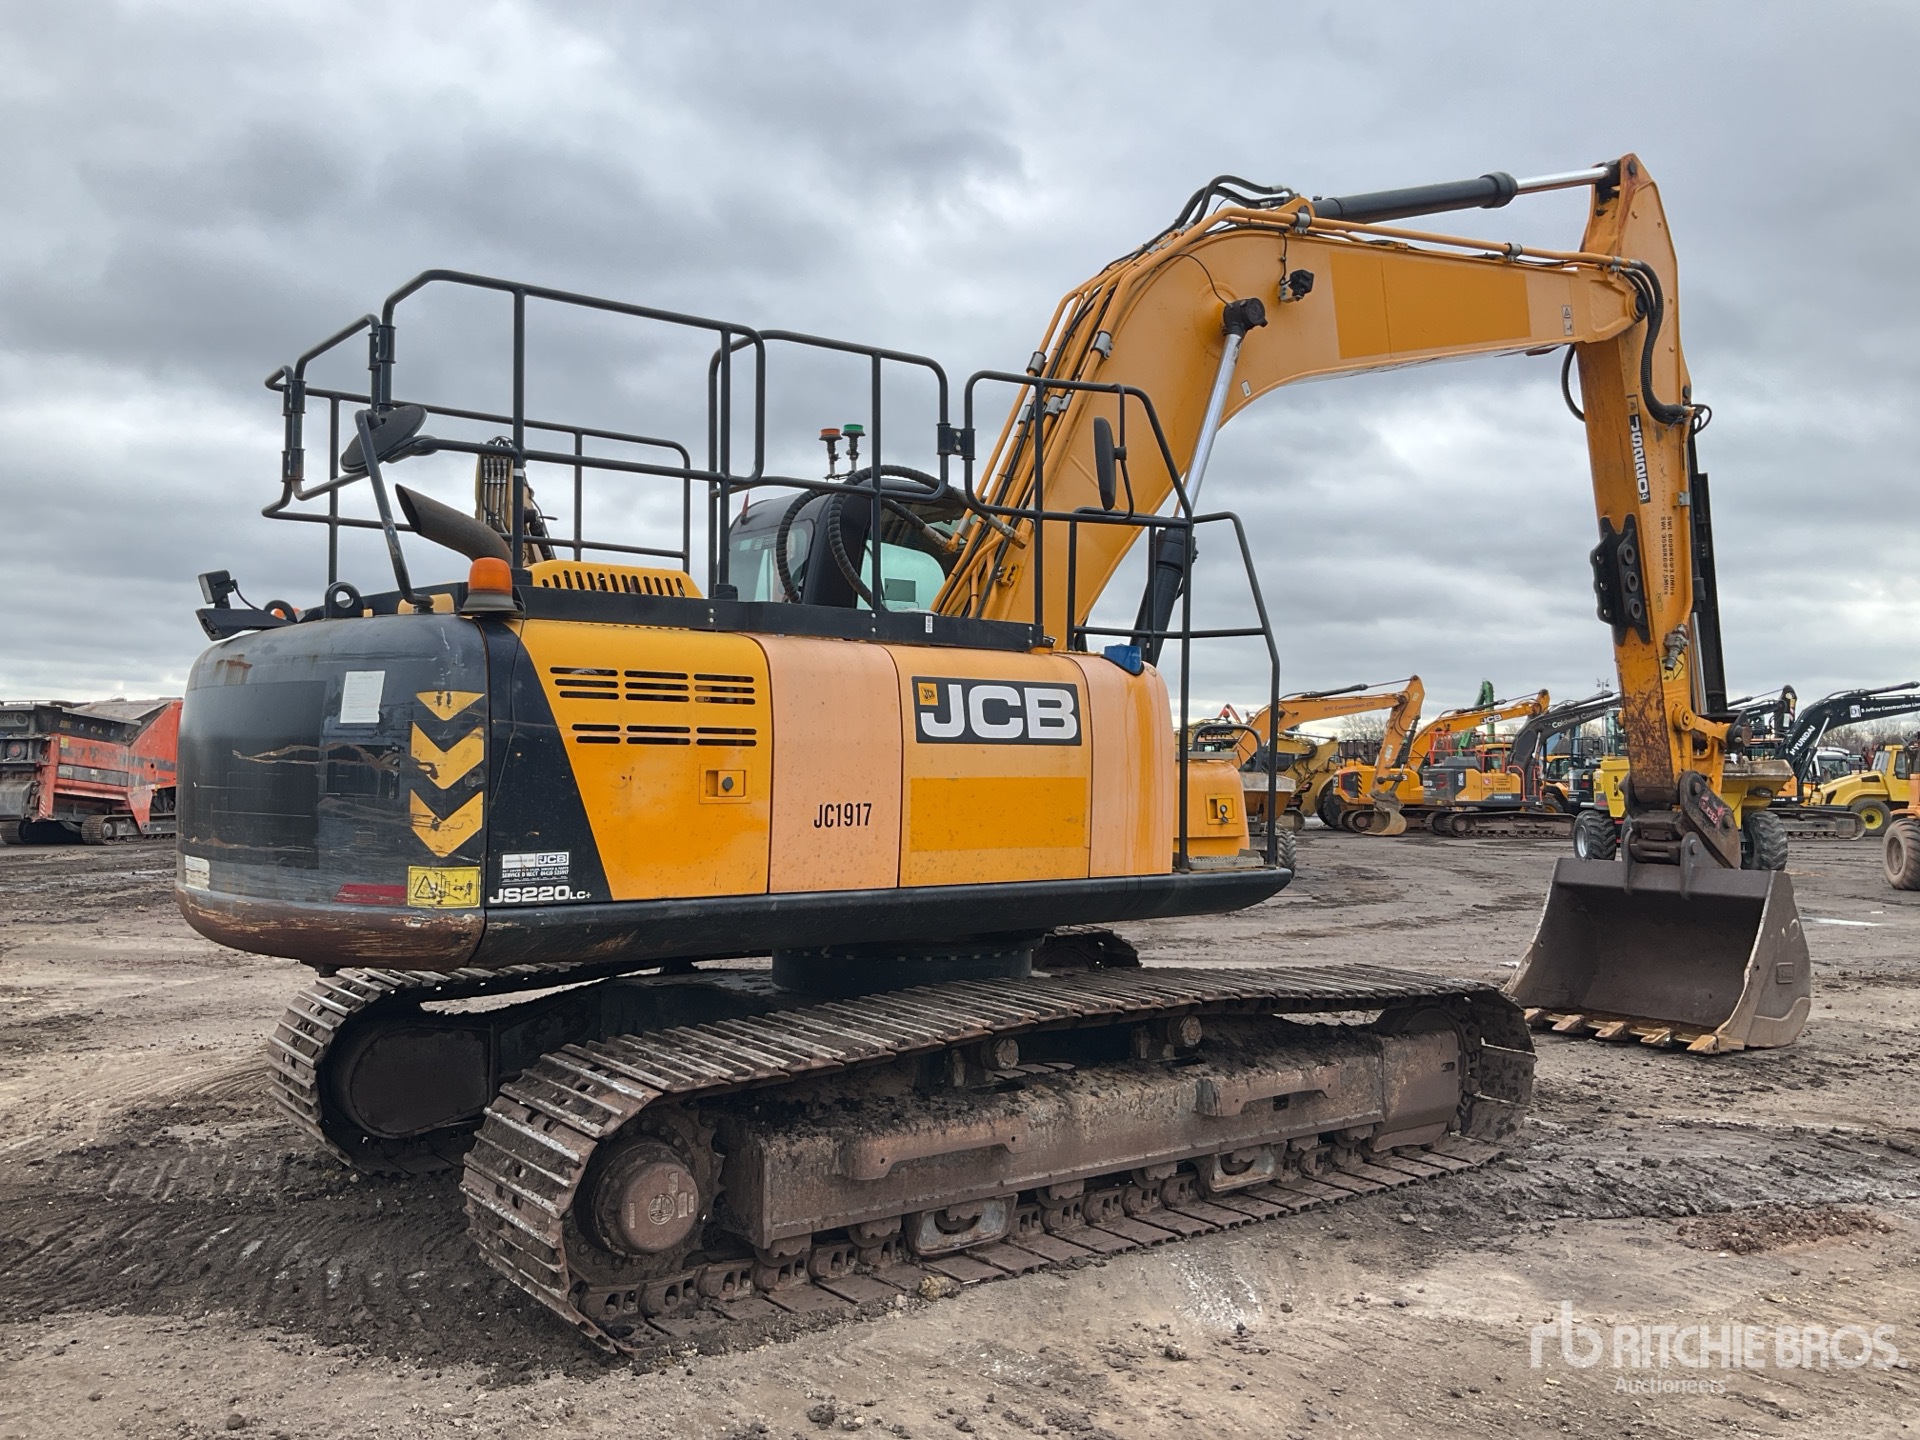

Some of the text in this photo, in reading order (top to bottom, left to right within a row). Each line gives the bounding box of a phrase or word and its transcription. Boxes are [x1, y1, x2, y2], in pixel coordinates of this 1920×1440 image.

[920, 683, 1078, 740] JCB
[1481, 713, 1502, 725] JCB
[1551, 714, 1580, 729] Caldwell
[1789, 725, 1816, 756] HYUNDAI
[813, 802, 872, 829] JC1917
[538, 854, 567, 864] JCB
